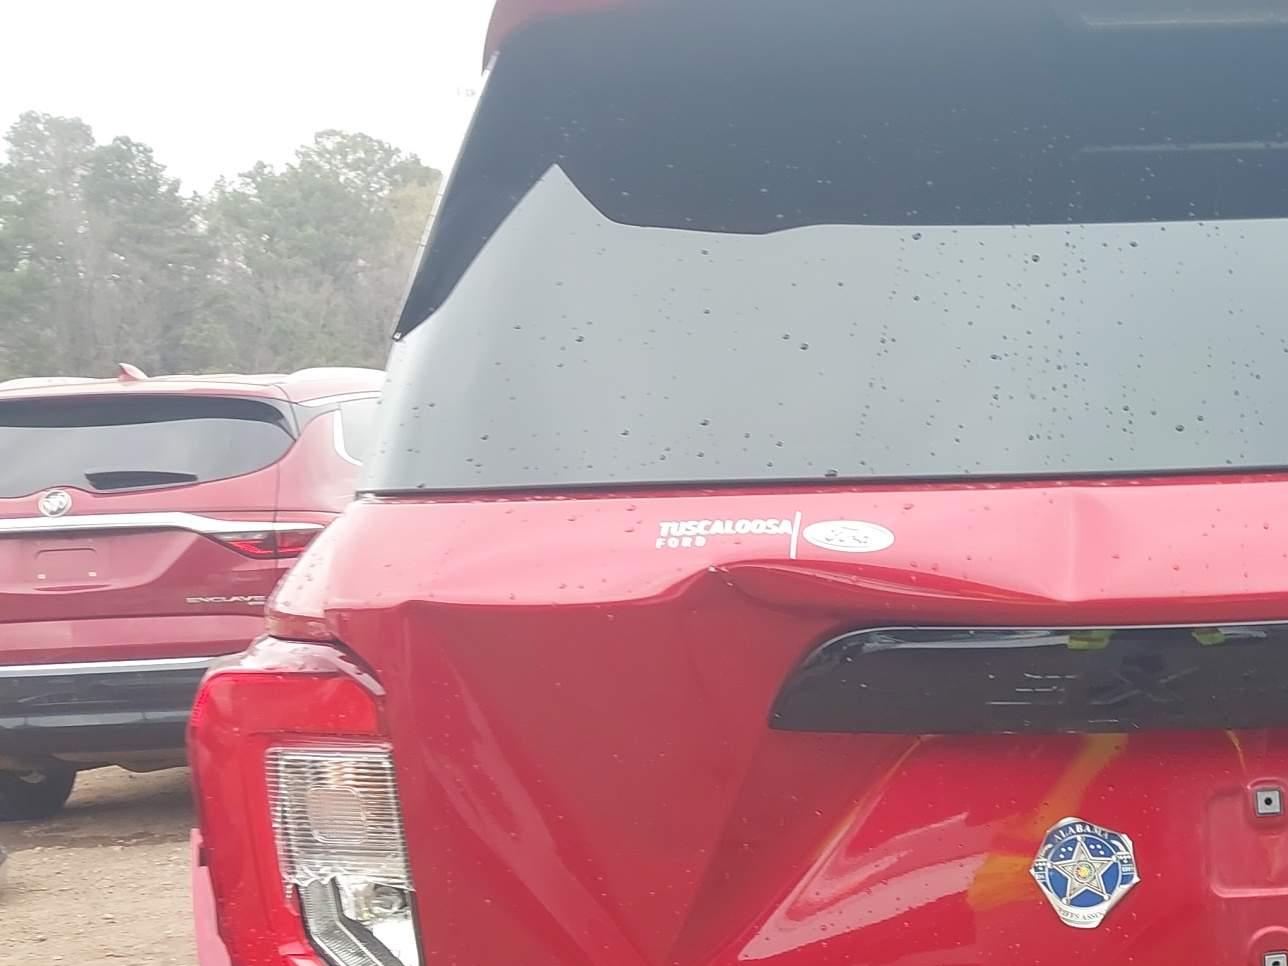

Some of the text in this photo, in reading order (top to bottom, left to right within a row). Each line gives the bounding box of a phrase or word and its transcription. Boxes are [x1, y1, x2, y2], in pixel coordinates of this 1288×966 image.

[658, 518, 793, 537] TUSCALOOSA
[655, 536, 706, 549] FORD
[1054, 823, 1109, 842] ALABAMA
